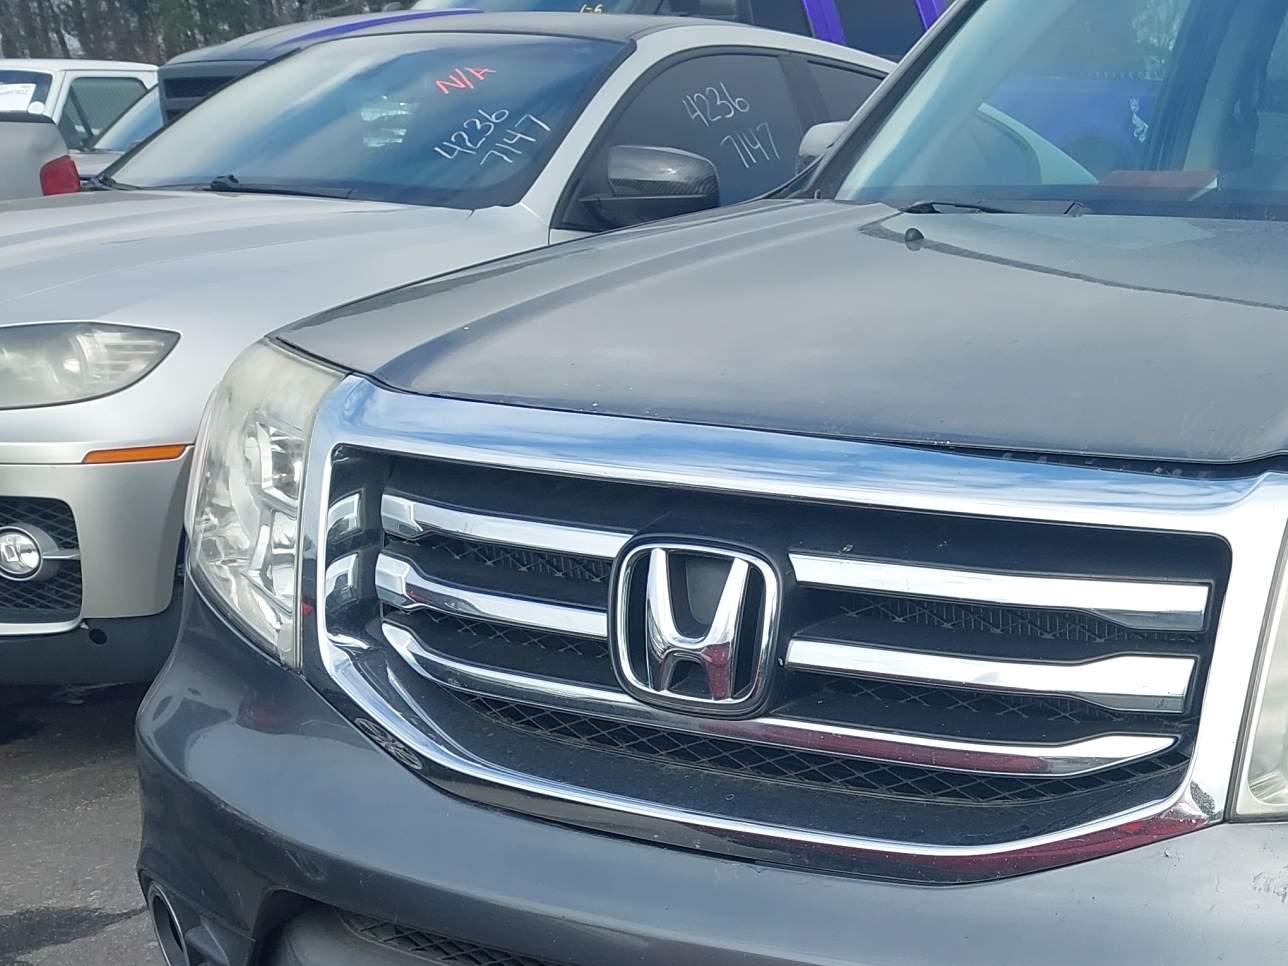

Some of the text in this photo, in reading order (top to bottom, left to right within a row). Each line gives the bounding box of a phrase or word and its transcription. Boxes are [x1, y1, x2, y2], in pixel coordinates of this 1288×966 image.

[435, 67, 497, 94] N/A
[682, 81, 750, 127] 4236
[434, 109, 510, 159] 4236
[480, 114, 551, 166] 7147
[720, 122, 781, 168] 7147
